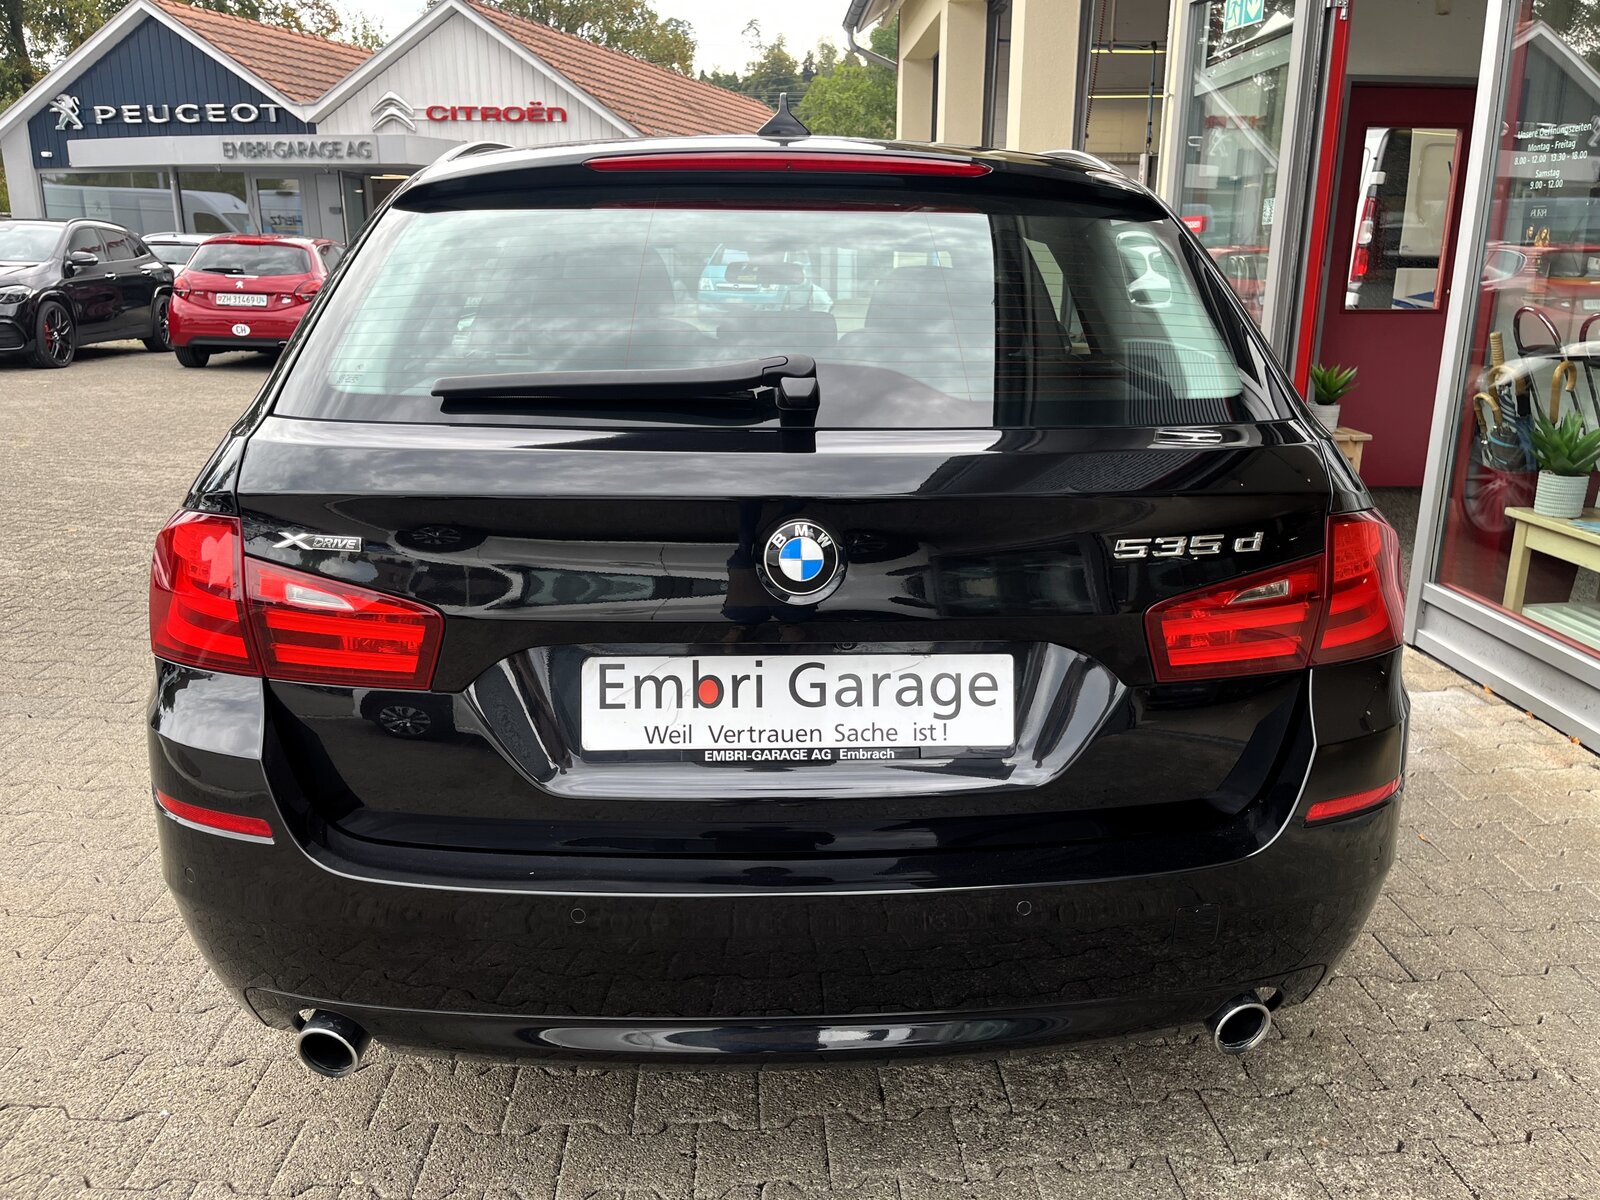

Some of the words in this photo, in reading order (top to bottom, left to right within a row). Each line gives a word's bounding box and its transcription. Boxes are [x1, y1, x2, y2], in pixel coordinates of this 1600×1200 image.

[93, 103, 281, 125] PEUGEOT
[1517, 129, 1539, 139] Unsere
[222, 140, 344, 160] EMBRI-GARAGE
[347, 140, 373, 159] AG
[1528, 143, 1550, 152] Montag
[1555, 140, 1576, 149] Freitag
[1514, 157, 1526, 165] 8.00
[1532, 155, 1546, 164] 12.00
[1550, 153, 1566, 162] 13.30
[1572, 150, 1588, 160] 18.00
[1535, 169, 1560, 178] Samstag
[1530, 181, 1542, 189] 9.00
[1548, 179, 1563, 188] 12.00
[235, 325, 246, 334] CH
[772, 523, 833, 549] BMW
[1113, 534, 1225, 559] 535
[1234, 531, 1264, 553] d
[598, 659, 764, 711] Embri
[788, 661, 999, 720] Garage
[643, 724, 693, 745] Weil
[707, 723, 823, 744] Vertrauen
[834, 722, 898, 743] Sache
[704, 748, 808, 761] EMBRI-GARAGE
[810, 749, 832, 761] AG
[839, 748, 895, 761] Embrach
